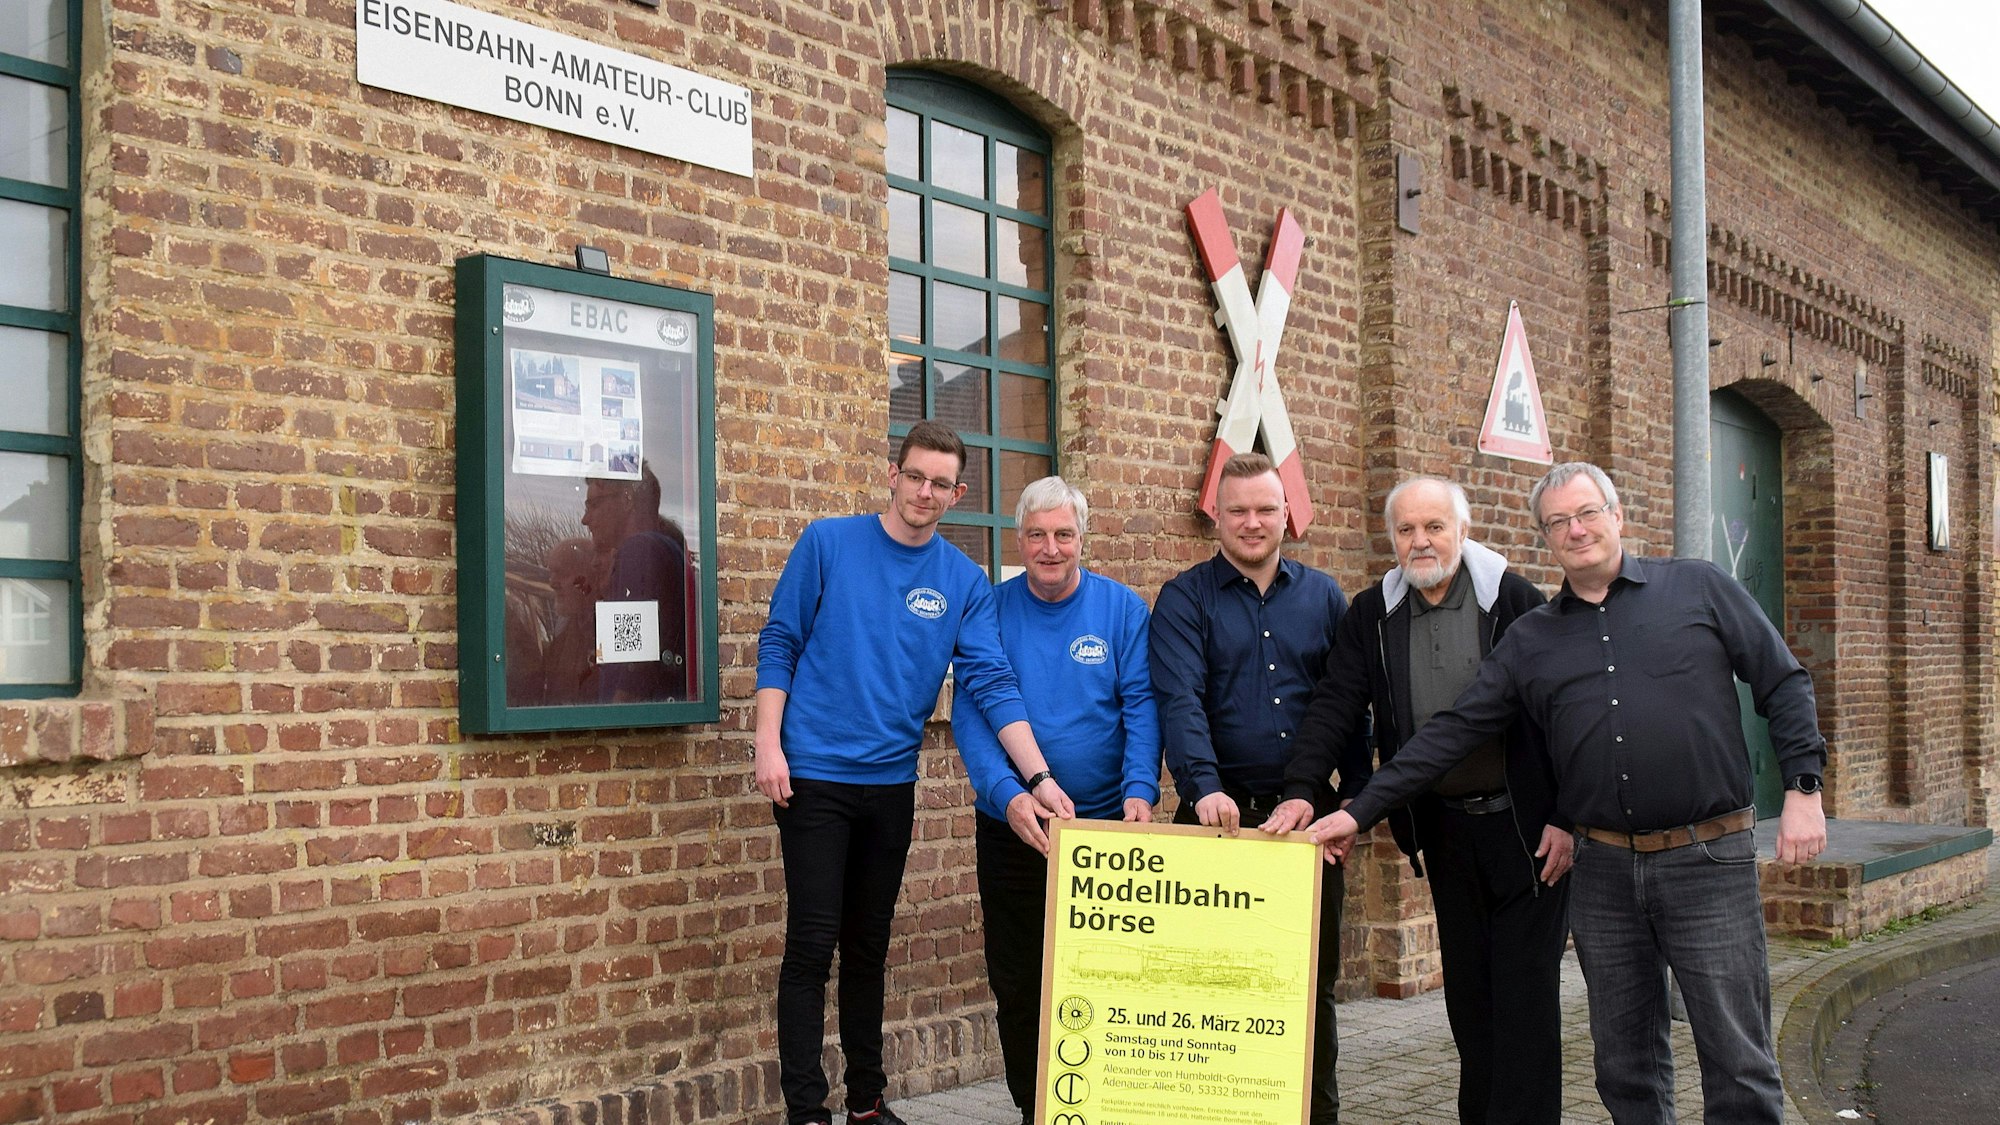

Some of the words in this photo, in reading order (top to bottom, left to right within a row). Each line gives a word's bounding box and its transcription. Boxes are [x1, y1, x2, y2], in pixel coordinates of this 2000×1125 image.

[363, 0, 748, 126] EISENBAHN-AMATEUR-CLUB
[505, 75, 583, 119] BONN
[596, 104, 639, 133] e.V.
[570, 301, 628, 334] EBAC
[1072, 845, 1164, 873] Große
[1071, 876, 1265, 910] Modellbahn-
[1069, 905, 1155, 934] börse
[1107, 1007, 1130, 1025] 25.
[1136, 1010, 1166, 1027] und
[1172, 1012, 1195, 1029] 26.
[1201, 1014, 1240, 1033] März
[1245, 1017, 1285, 1036] 2023
[1105, 1032, 1157, 1048] Samstag
[1160, 1038, 1183, 1048] und
[1186, 1039, 1237, 1055] Sonntag
[1105, 1048, 1126, 1057] von
[1131, 1048, 1145, 1058] 10
[1148, 1049, 1166, 1061] bis
[1170, 1051, 1184, 1062] 17
[1188, 1053, 1210, 1064] Uhr
[1102, 1077, 1176, 1092] Adenauer-Allee
[1179, 1083, 1194, 1095] 50,
[1198, 1084, 1229, 1097] 53332
[1232, 1088, 1280, 1101] Bornheim
[1103, 1063, 1152, 1077] Alexander
[1154, 1070, 1172, 1078] von
[1175, 1070, 1286, 1088] Humboldt-Gymnasium
